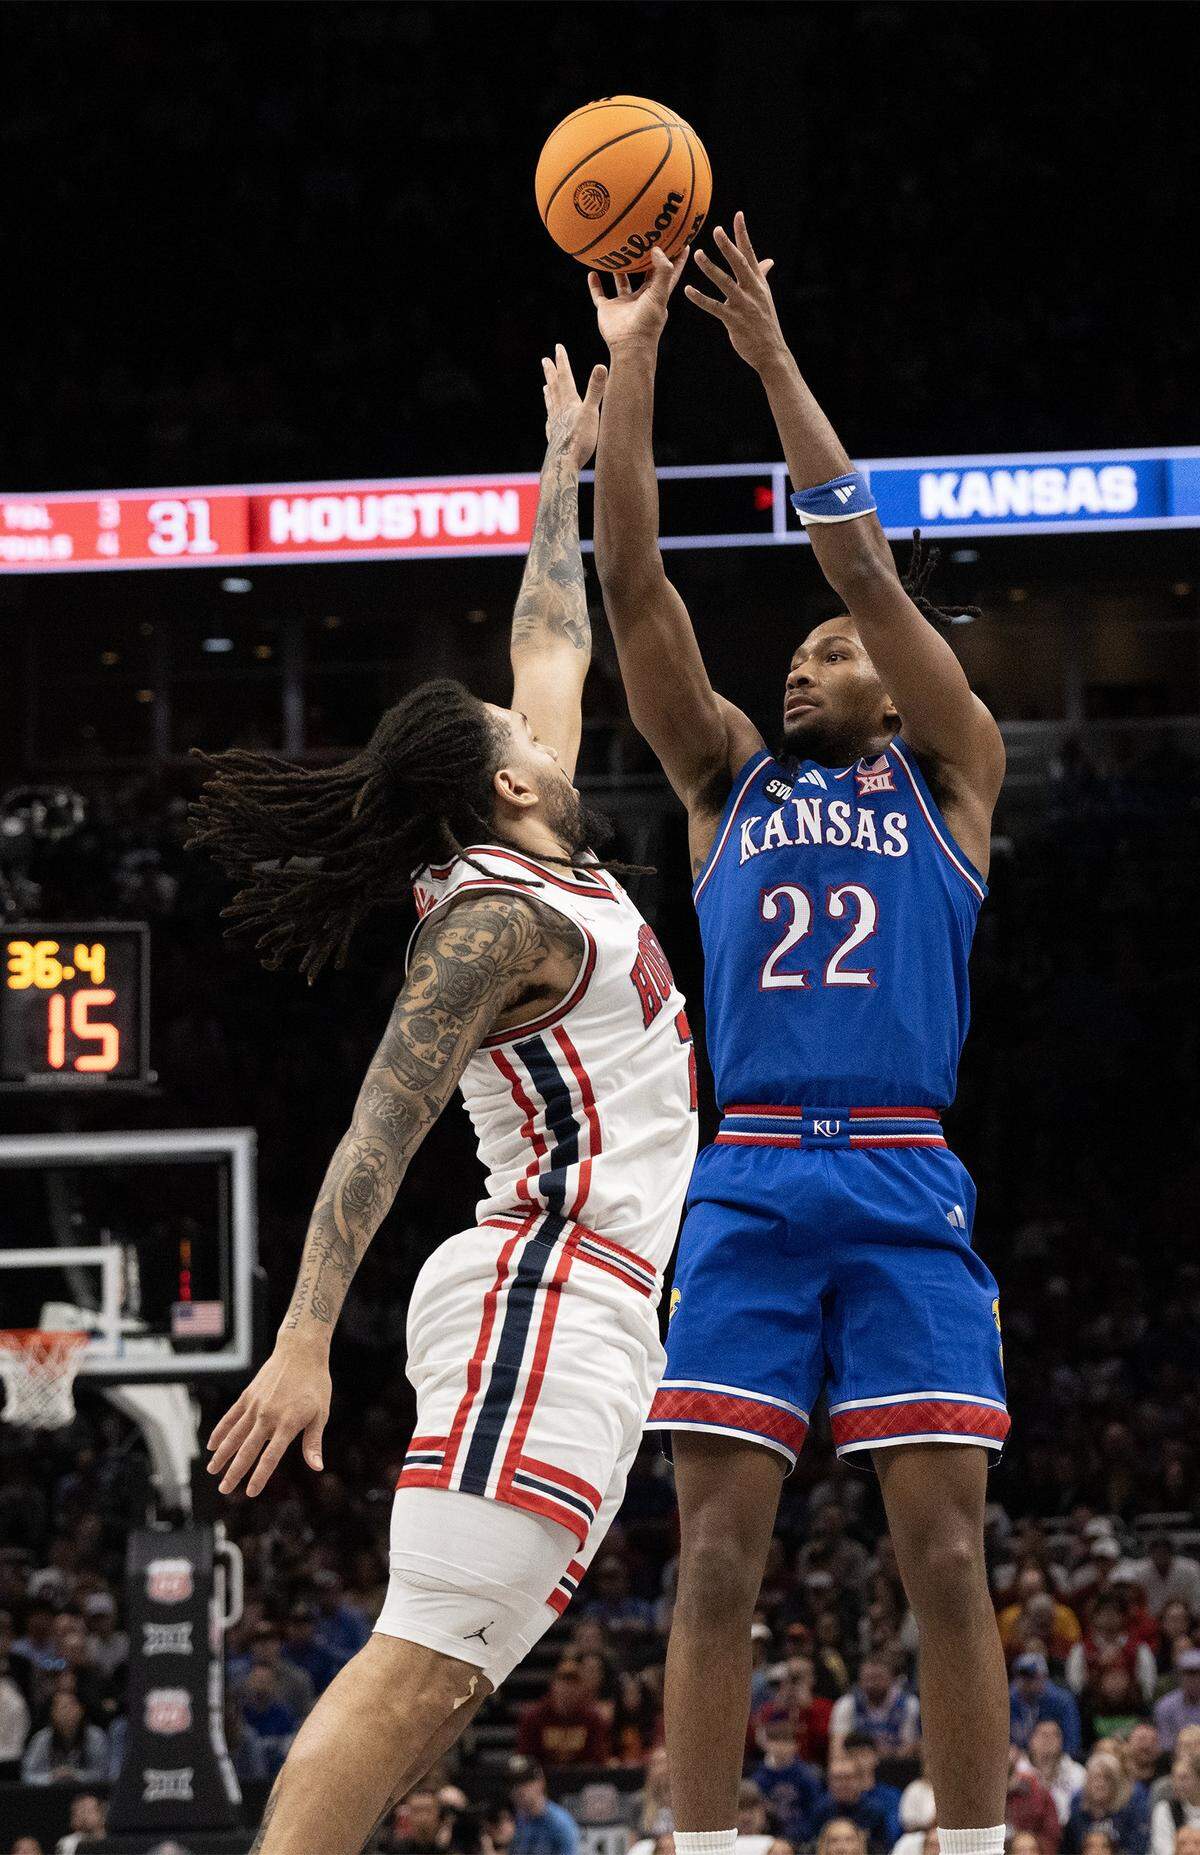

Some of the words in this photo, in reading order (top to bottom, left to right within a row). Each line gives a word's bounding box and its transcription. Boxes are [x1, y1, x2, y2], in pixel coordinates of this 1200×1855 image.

[596, 191, 685, 270] Wilson
[269, 490, 520, 544] HOUSTON
[919, 466, 1138, 520] KANSAS
[147, 498, 219, 556] 31
[739, 797, 910, 866] KANSAS
[7, 940, 106, 989] 36.4
[759, 882, 878, 990] 22
[47, 989, 119, 1072] 15
[812, 1119, 841, 1138] KU
